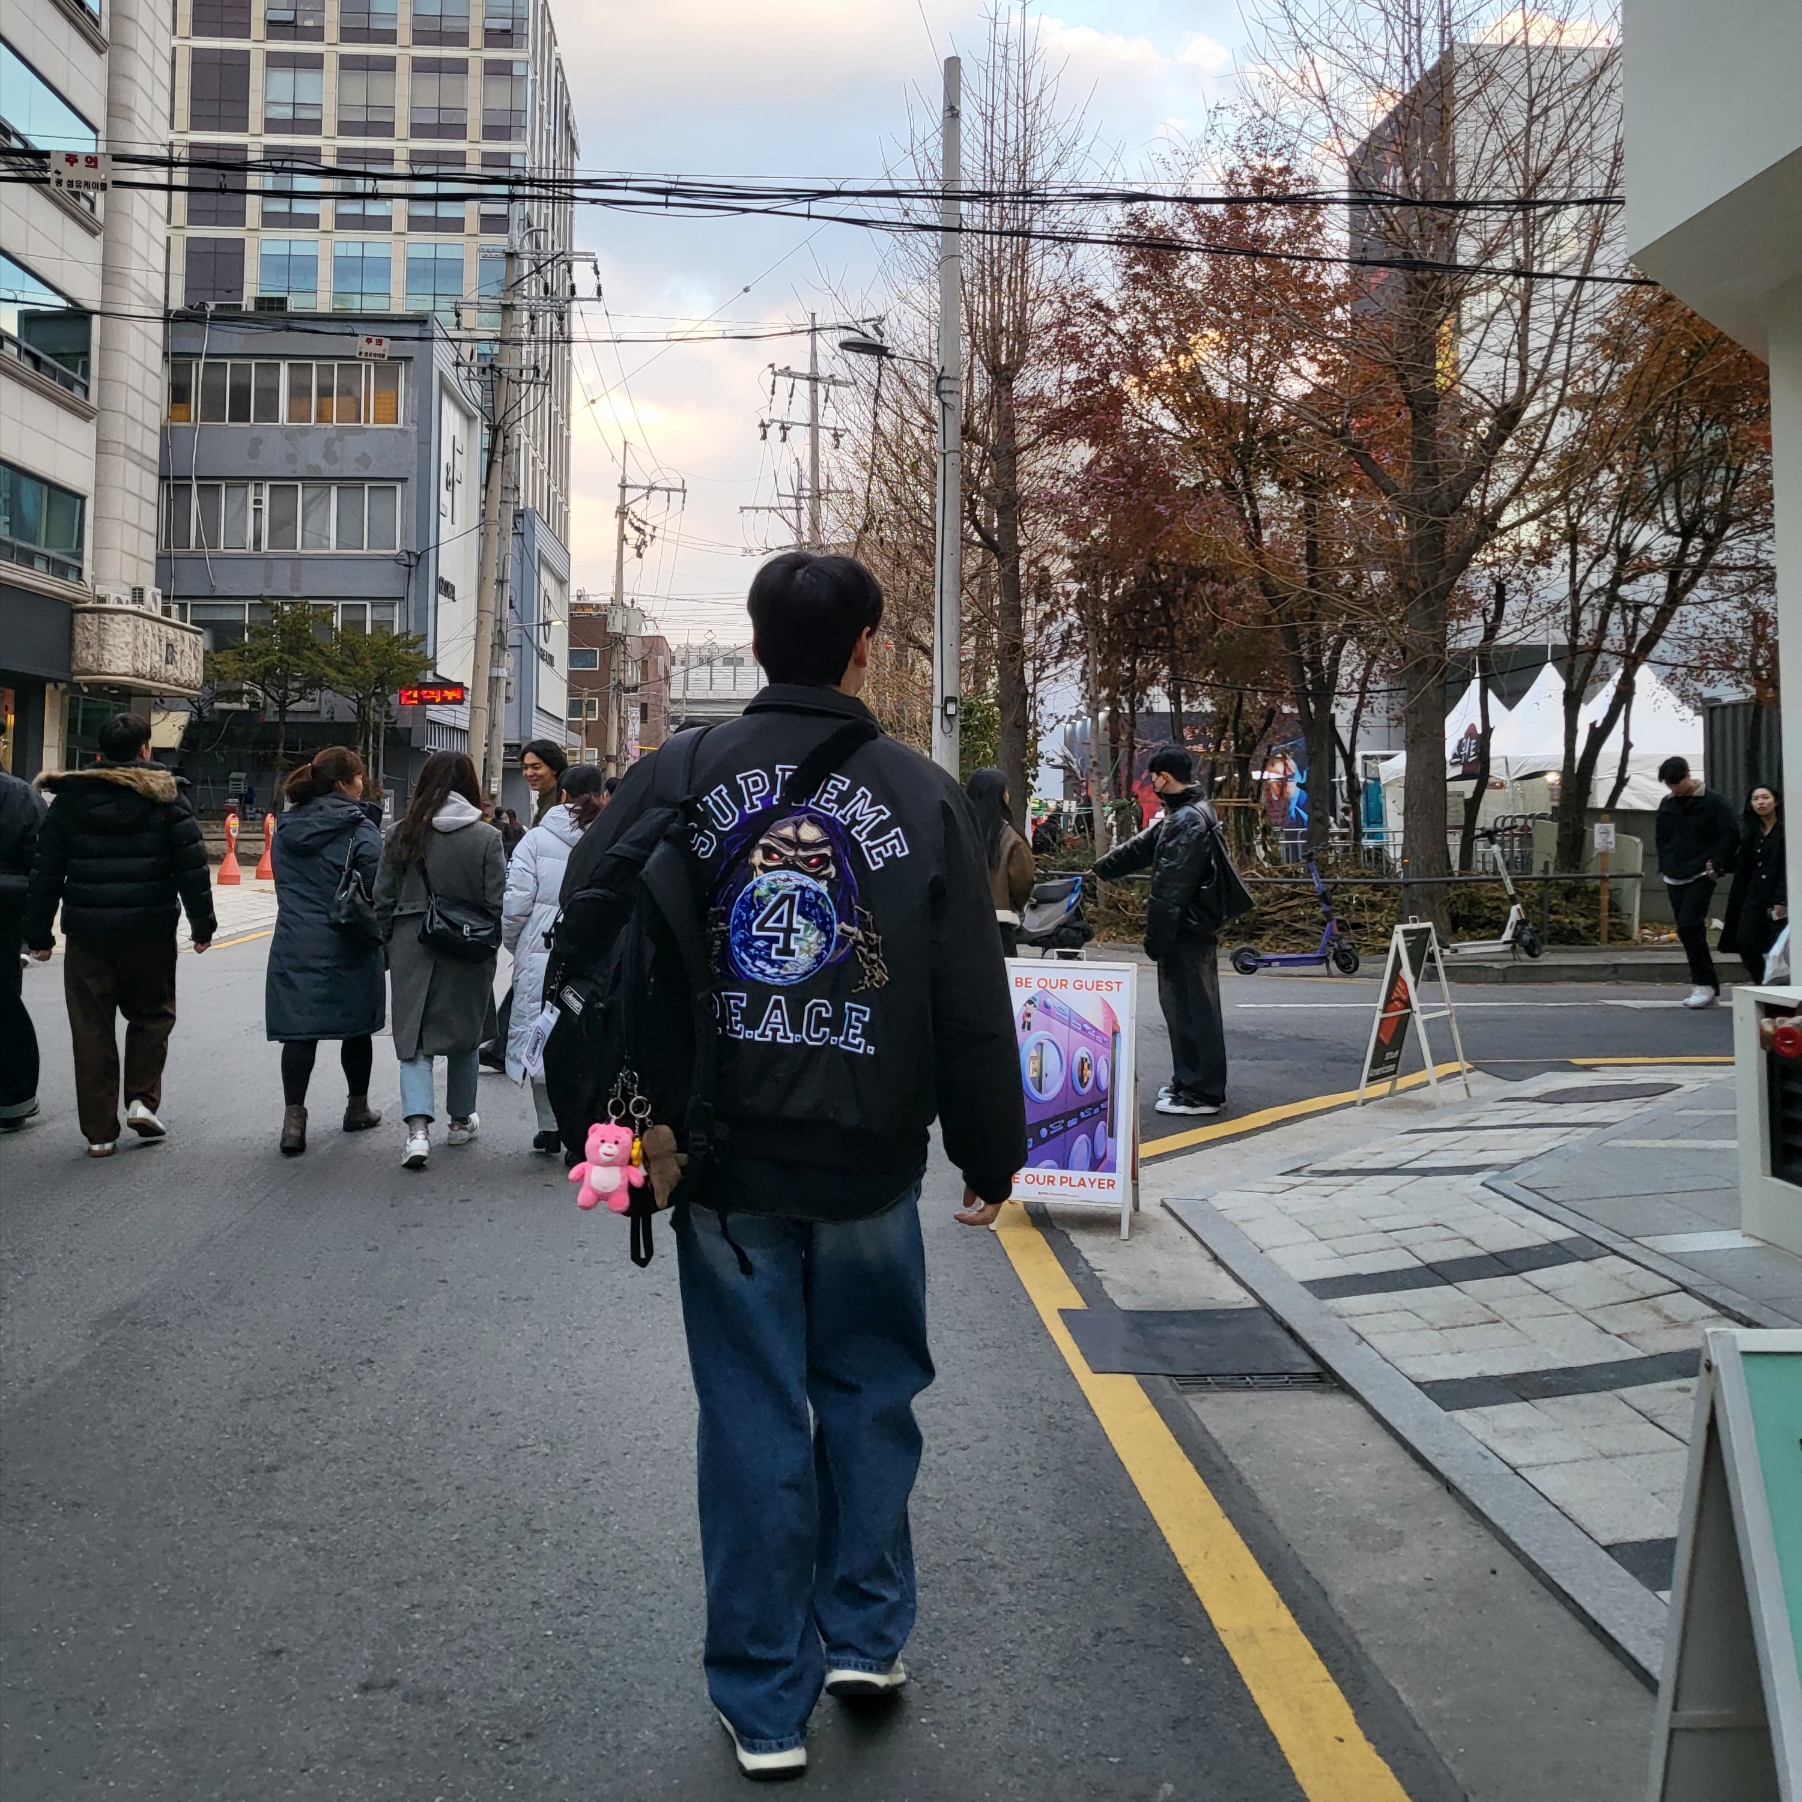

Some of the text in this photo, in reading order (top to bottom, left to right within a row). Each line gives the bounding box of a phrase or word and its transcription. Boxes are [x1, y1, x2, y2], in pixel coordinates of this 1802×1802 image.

[65, 153, 99, 169] 주의
[752, 889, 804, 961] 4
[1014, 977, 1124, 993] BE OUR GUEST
[712, 991, 875, 1055] .E.A.C.E.
[1011, 1173, 1116, 1191] E OUR PLAYER
